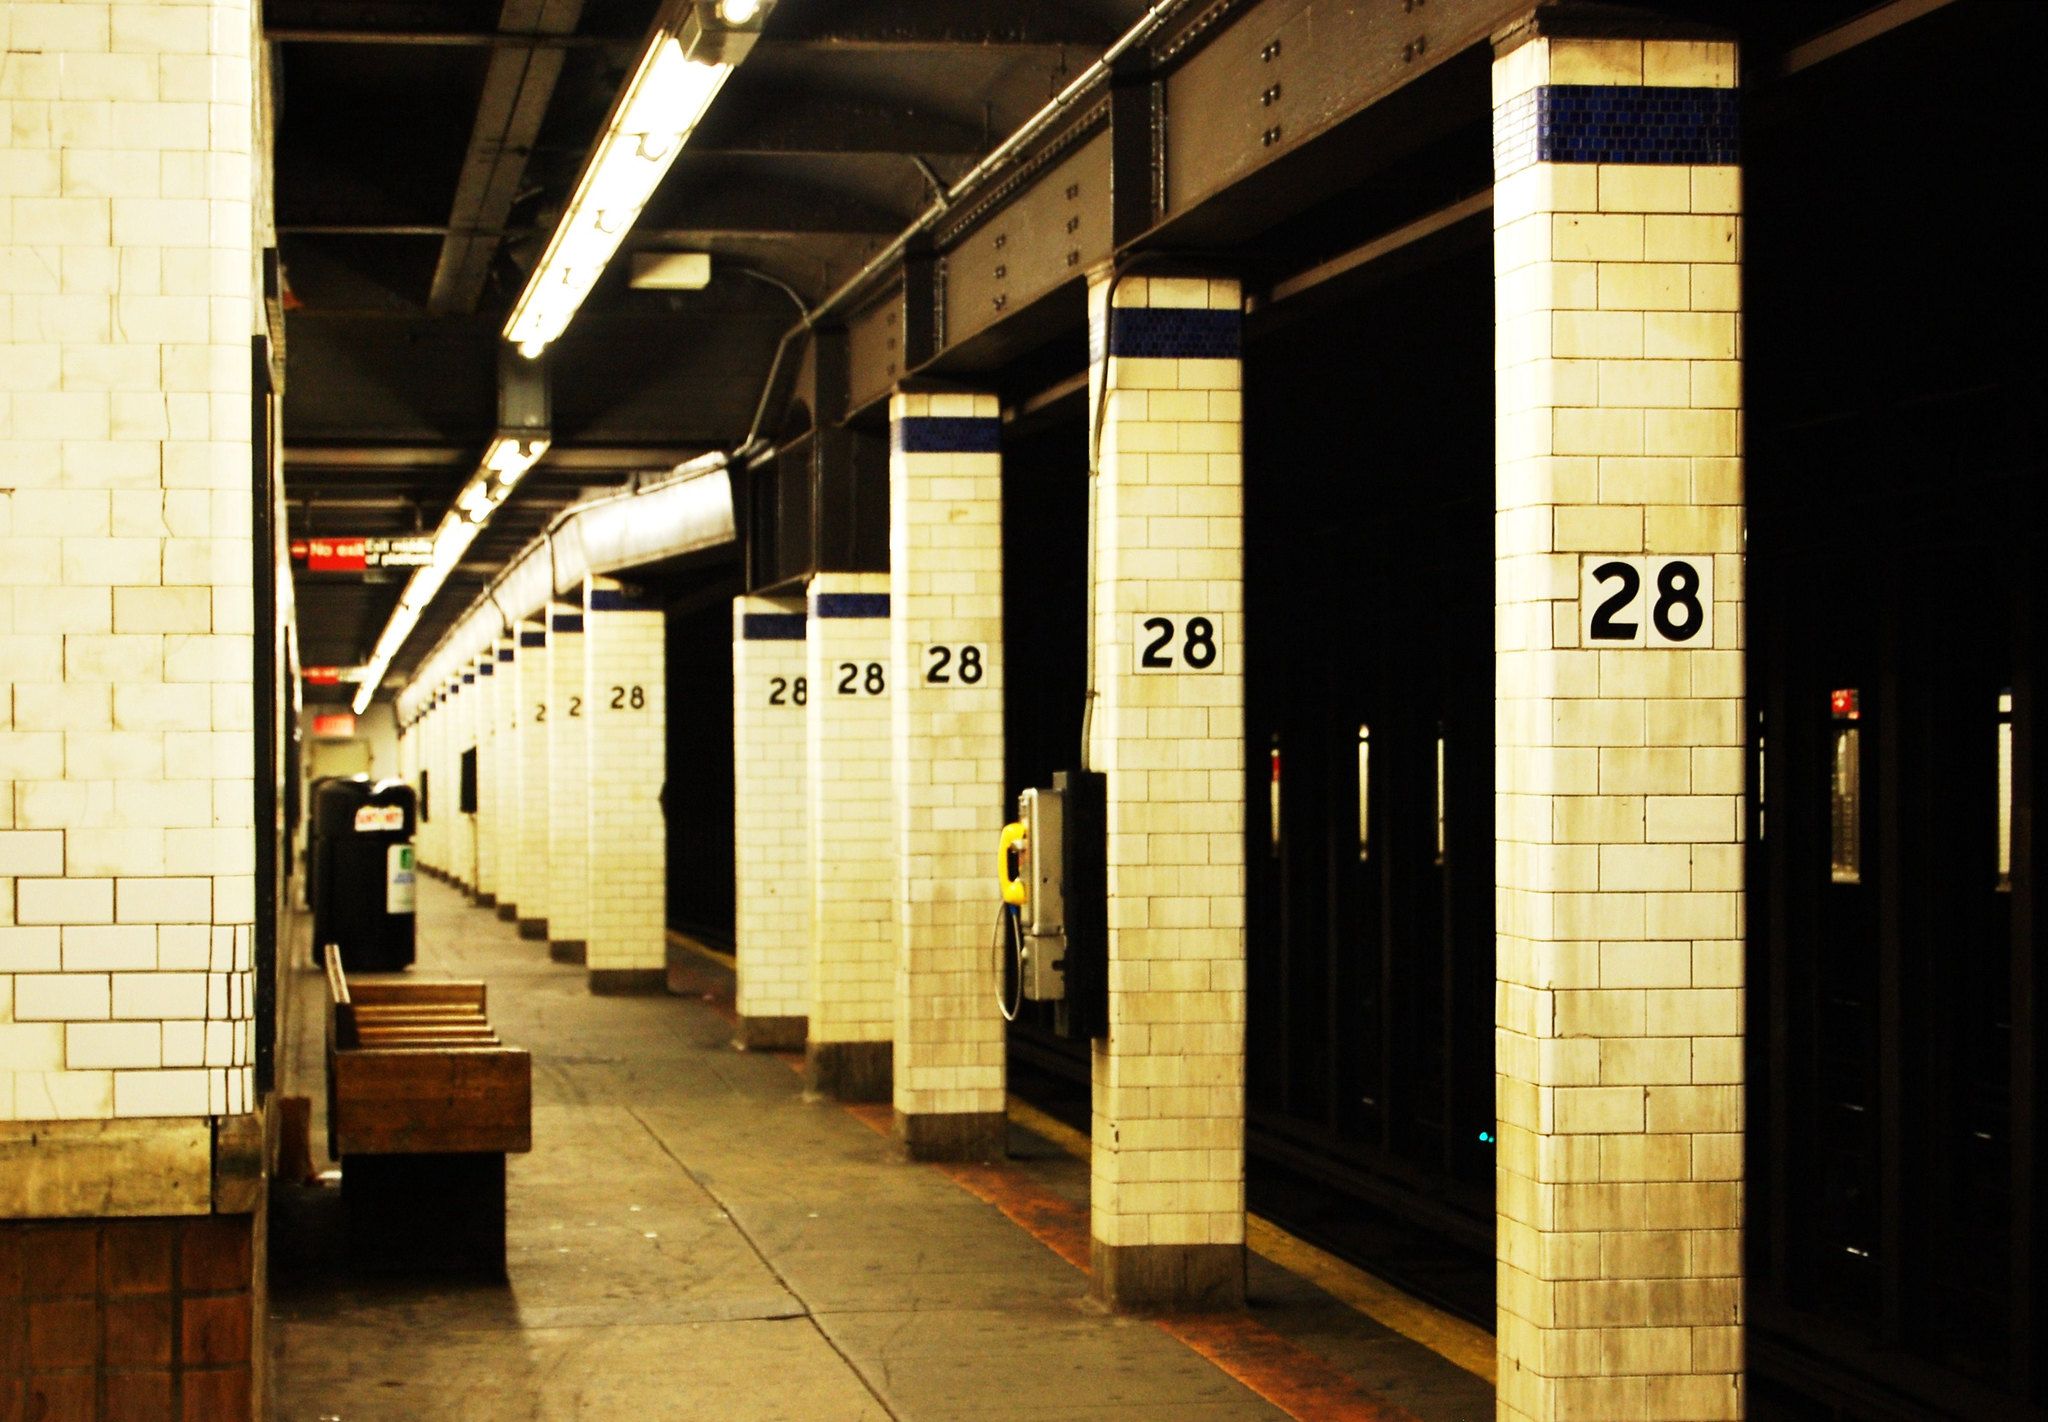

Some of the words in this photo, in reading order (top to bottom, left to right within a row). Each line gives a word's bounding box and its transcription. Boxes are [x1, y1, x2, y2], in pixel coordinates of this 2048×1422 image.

[1591, 561, 1703, 642] 28
[1142, 616, 1217, 670] 28
[838, 662, 885, 695] 28
[926, 645, 983, 685] 28
[611, 685, 645, 709] 28
[769, 677, 807, 706] 28
